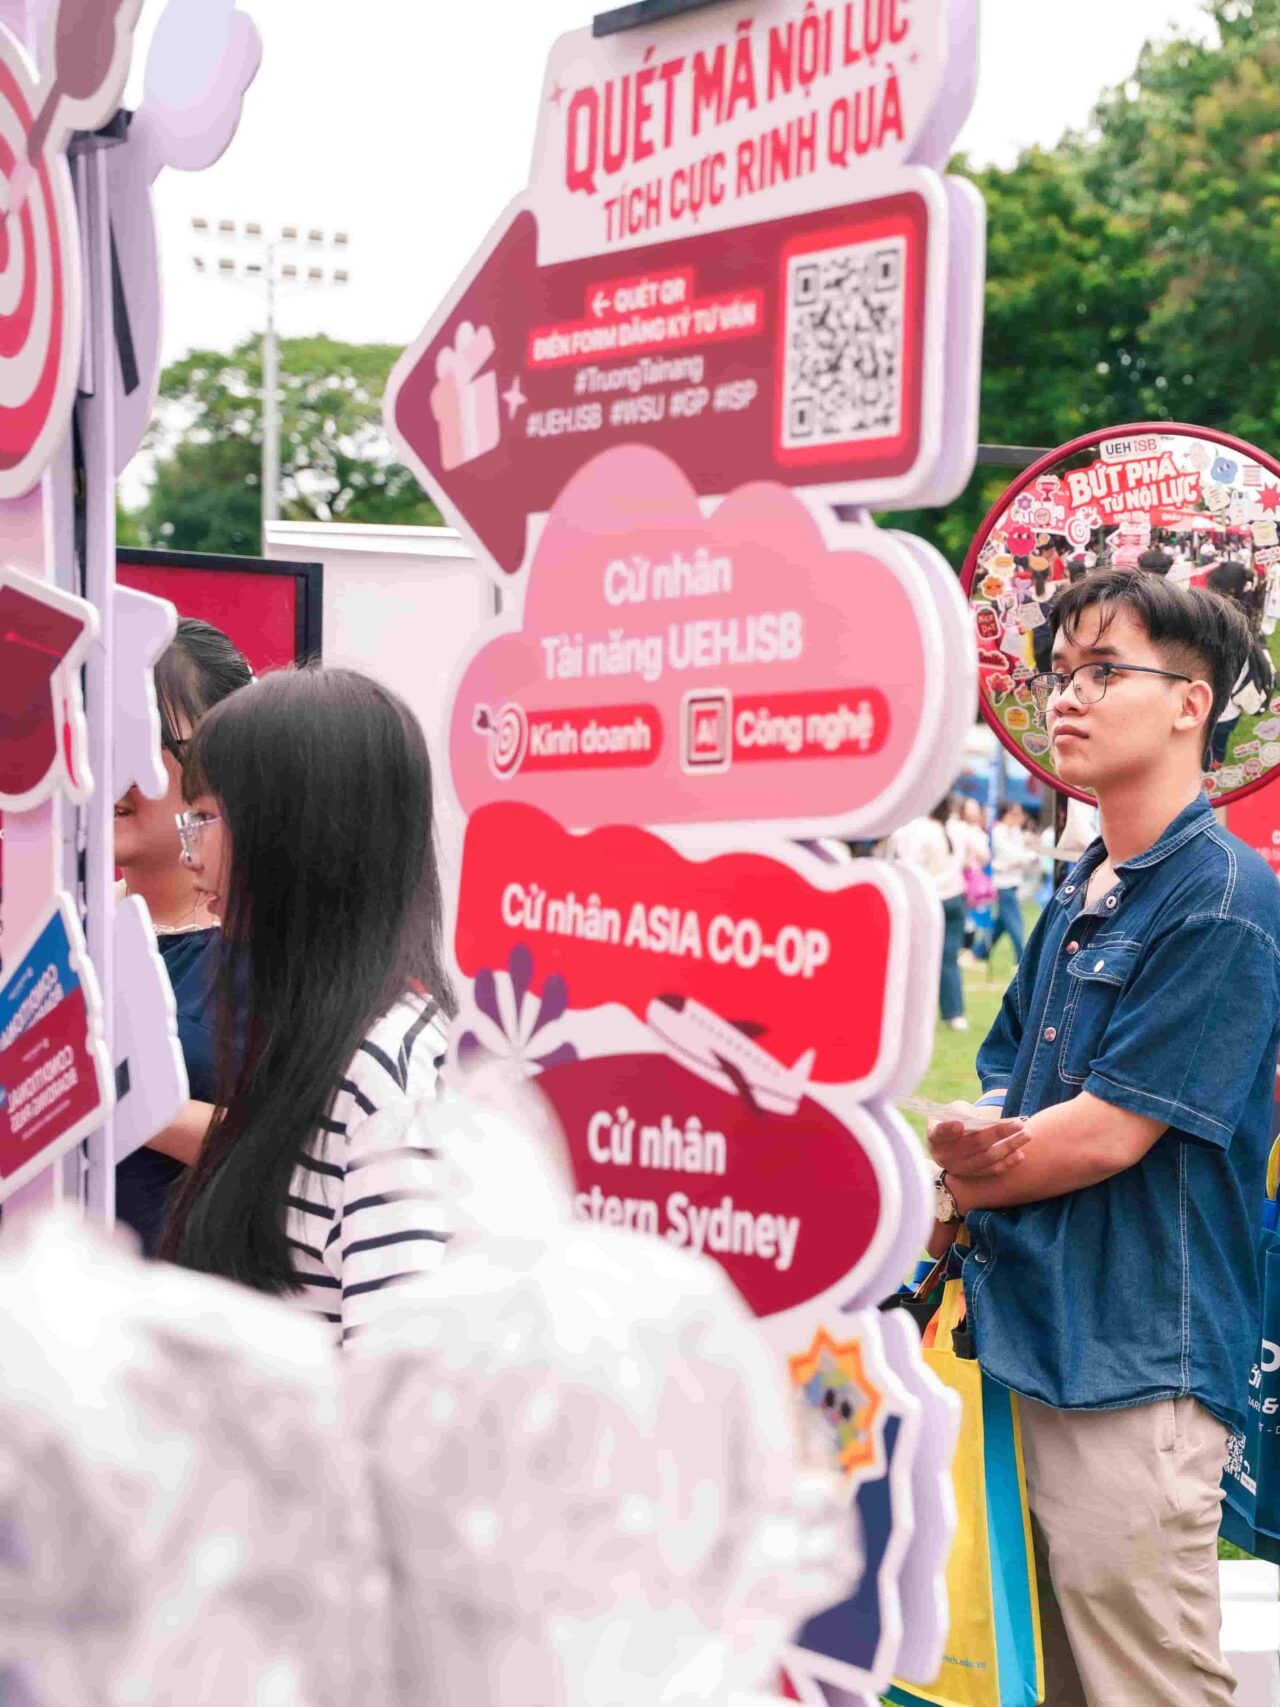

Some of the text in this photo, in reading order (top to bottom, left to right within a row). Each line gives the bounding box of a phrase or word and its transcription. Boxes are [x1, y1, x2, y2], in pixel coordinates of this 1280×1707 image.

[565, 46, 685, 195] QUÉT
[691, 19, 757, 137] MÃ
[767, 0, 834, 98] NỘI
[603, 62, 905, 242] TÍCH CỰC RINH QUÀ
[659, 277, 686, 305] QR
[572, 325, 617, 355] FORM
[1105, 441, 1132, 456] UEH
[1067, 451, 1178, 508] BỨT PHÁ
[1100, 473, 1199, 513] TỪ NỘI LỰC
[653, 546, 732, 601] nhân
[541, 611, 803, 682] Tài năng UEH.ISB
[530, 718, 651, 758] Kinh doanh
[736, 701, 874, 752] Công nghệ
[502, 882, 830, 979] Cử nhân ASIA CO-OP
[588, 1107, 726, 1176] Cử nhân
[574, 1186, 800, 1272] stern Sydney
[1262, 1397, 1280, 1415] &
